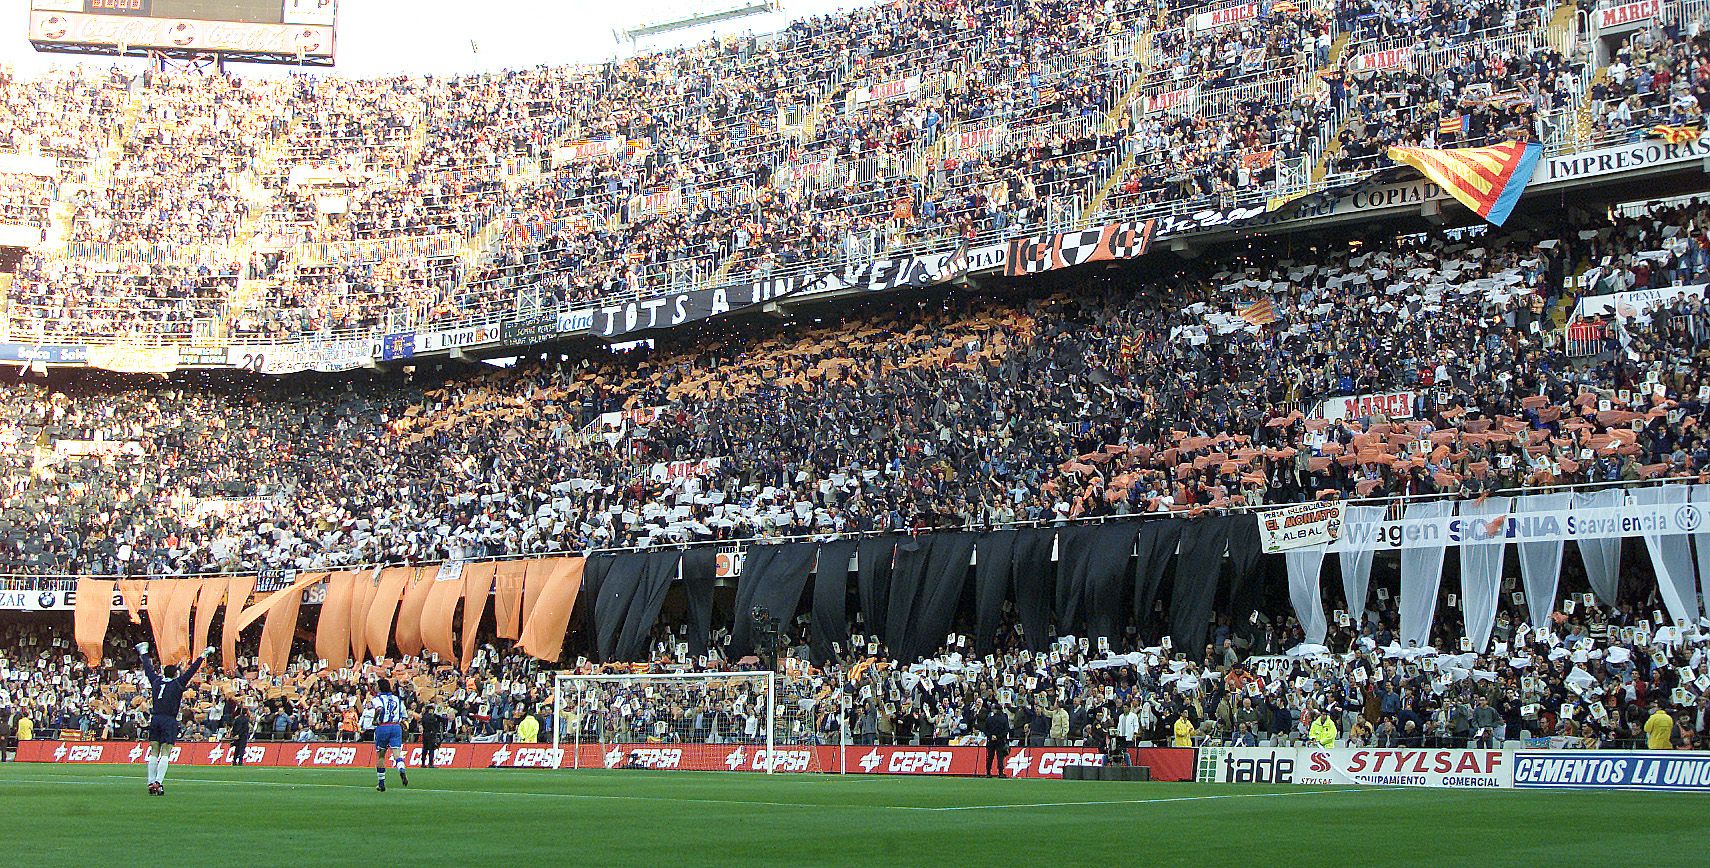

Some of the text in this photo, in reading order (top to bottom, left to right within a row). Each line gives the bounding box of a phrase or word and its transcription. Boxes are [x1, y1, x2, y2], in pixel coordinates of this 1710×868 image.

[1603, 0, 1659, 26] MARCA
[1265, 508, 1340, 531] EL MONIATO
[1284, 527, 1323, 541] ALBAL
[157, 684, 166, 699] 1
[69, 745, 104, 761] CEPSA
[314, 747, 357, 765] CEPSA
[888, 751, 953, 773] CEPSA
[1347, 751, 1503, 774] STYLSAF
[1224, 751, 1294, 784] tade
[1515, 758, 1628, 784] CEMENTOS
[1631, 759, 1660, 785] LA
[1442, 776, 1500, 787] COMERCIAL
